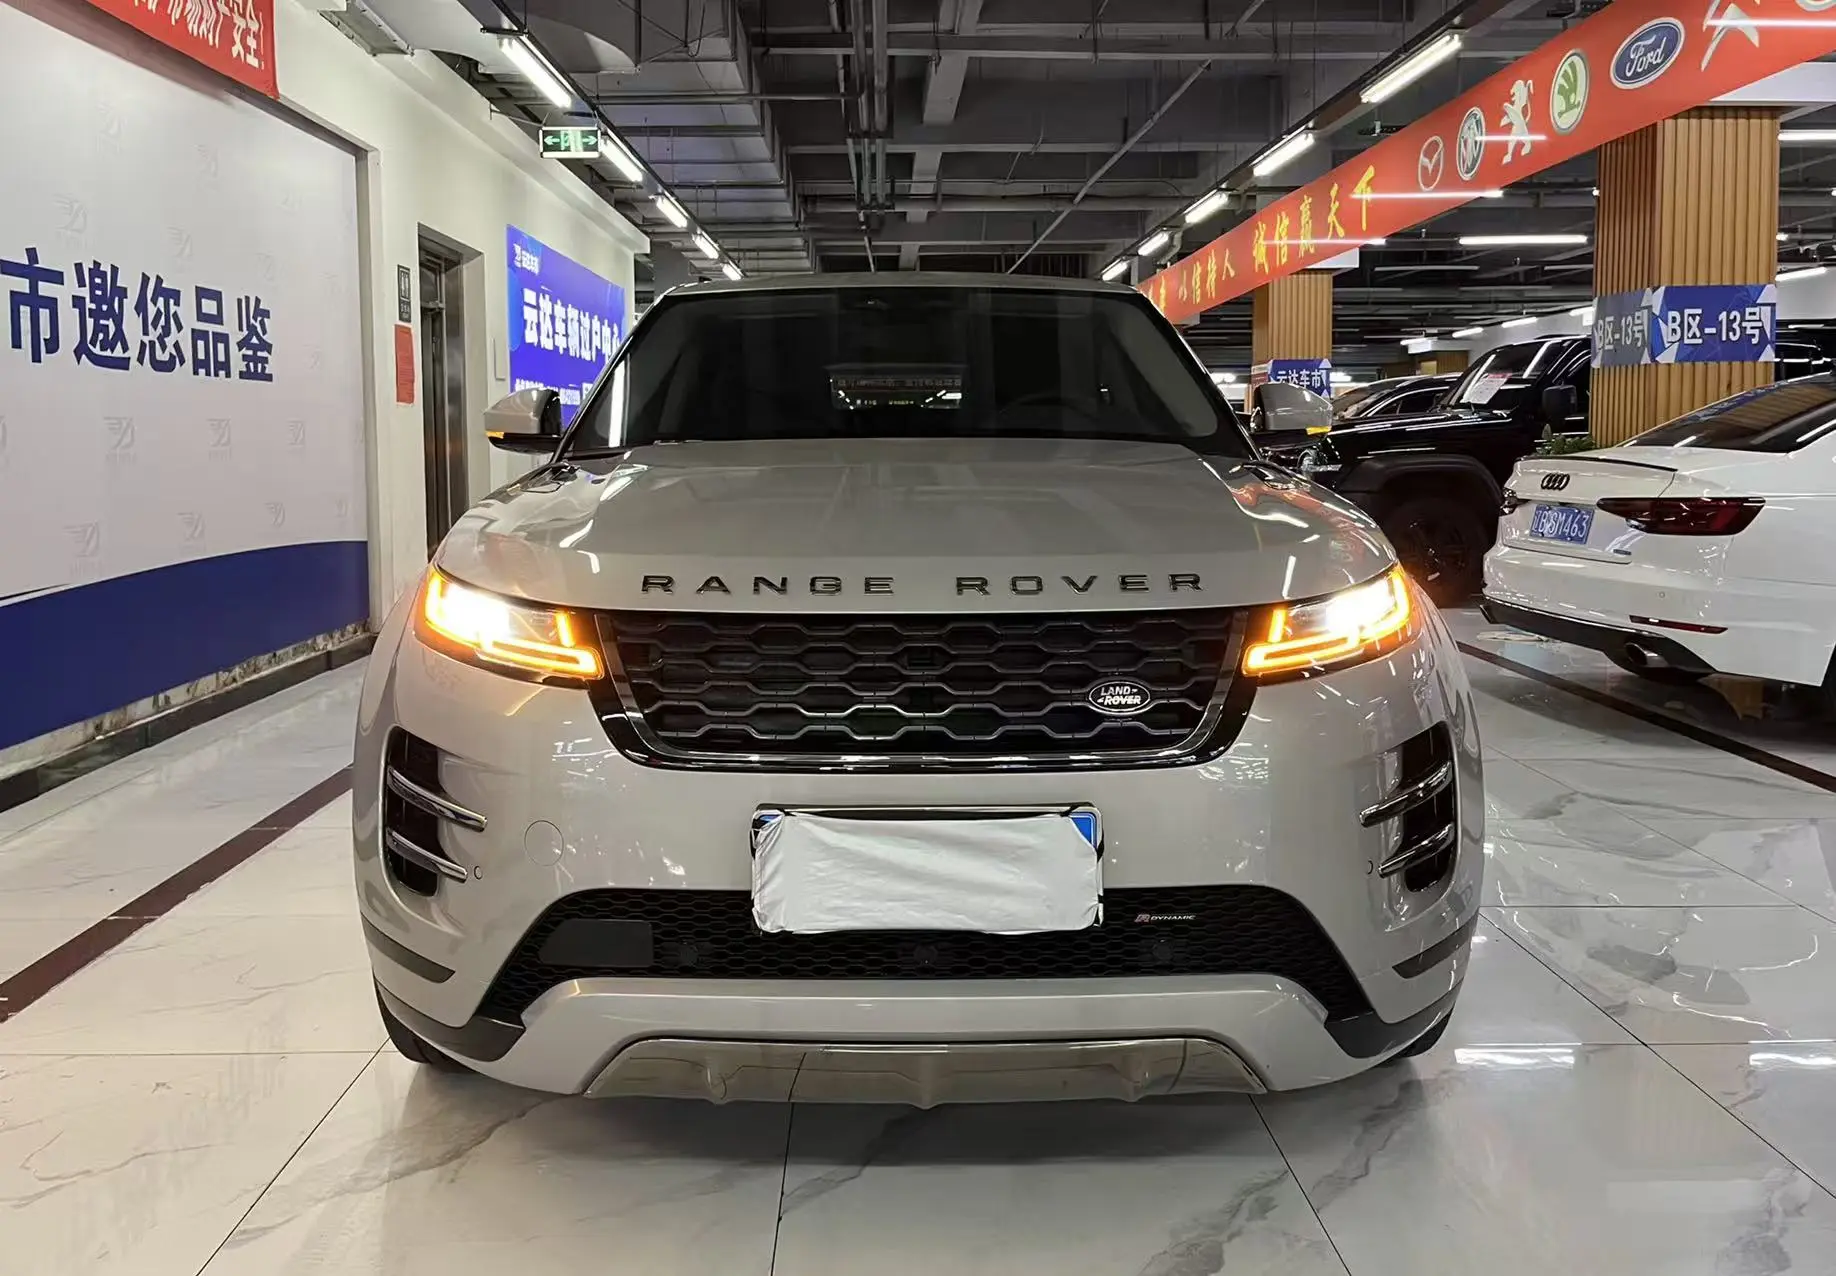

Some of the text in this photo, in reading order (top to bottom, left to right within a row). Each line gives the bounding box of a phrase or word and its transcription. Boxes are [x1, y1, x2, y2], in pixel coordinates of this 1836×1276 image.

[1625, 36, 1667, 77] Ford
[0, 247, 273, 382] 市邀您品鉴
[1597, 308, 1644, 350] B区-13号
[1666, 307, 1763, 345] B区-13号
[1276, 368, 1321, 388] 云达车市
[642, 573, 1203, 597] RANGE ROVER
[1101, 686, 1131, 696] LAND
[1104, 695, 1141, 706] ROVER
